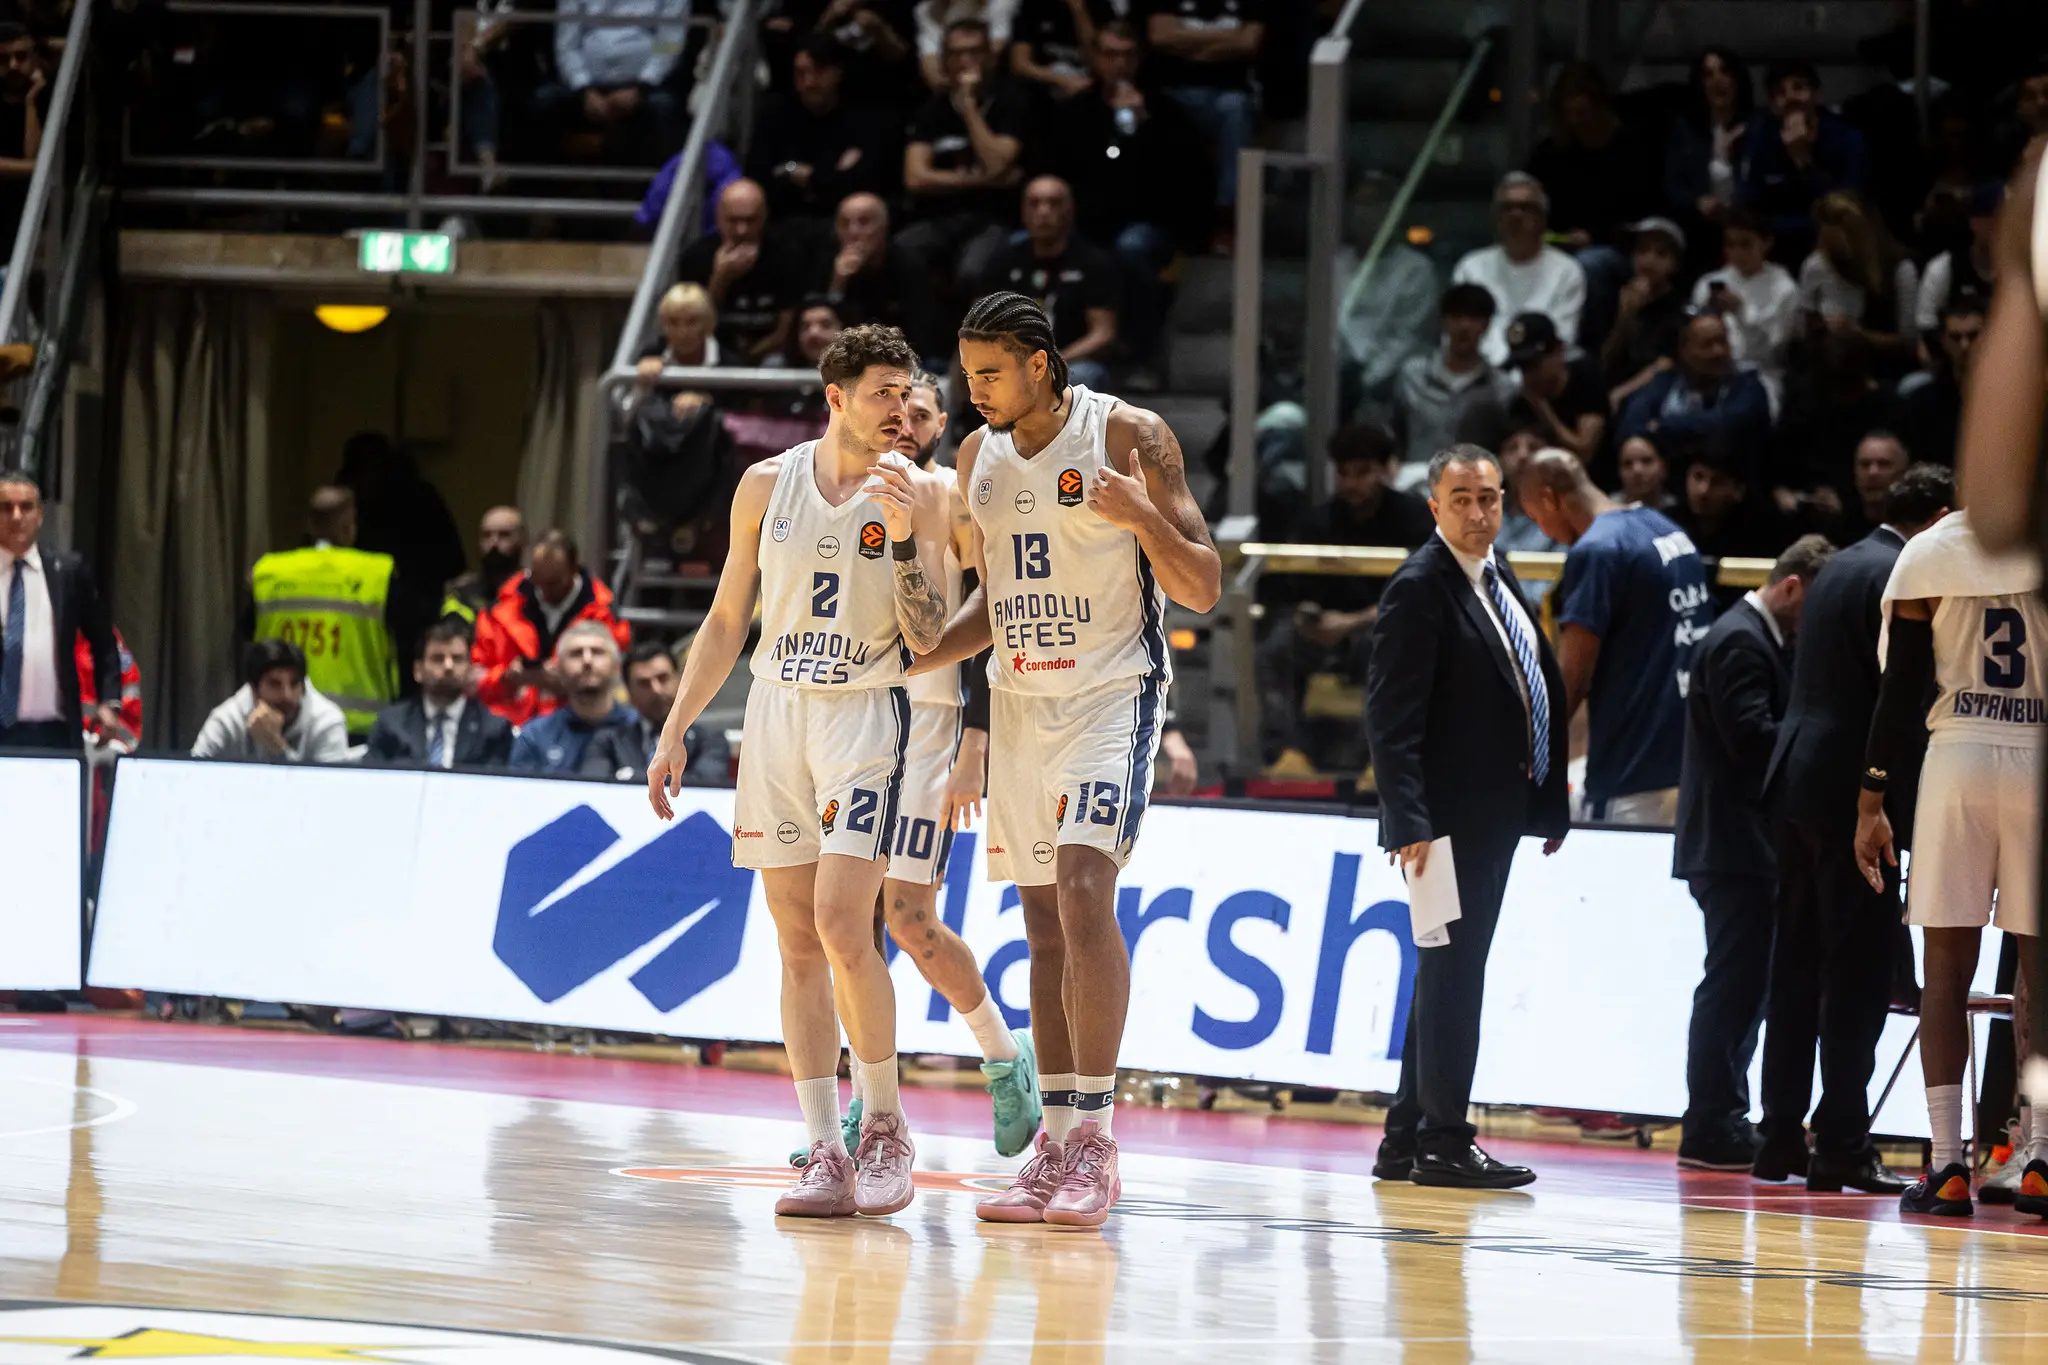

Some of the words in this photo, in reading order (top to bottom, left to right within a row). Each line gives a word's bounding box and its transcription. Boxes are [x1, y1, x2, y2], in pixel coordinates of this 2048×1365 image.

[1011, 532, 1052, 580] 13
[811, 571, 840, 619] 2
[994, 593, 1091, 628] ANADOLU
[770, 631, 871, 666] ANADOLU
[1006, 621, 1077, 649] EFES
[1983, 607, 2027, 689] 3
[781, 658, 849, 685] EFES
[1026, 657, 1076, 671] corendon
[846, 787, 879, 835] 2
[1074, 780, 1121, 827] 13
[895, 816, 937, 860] 10
